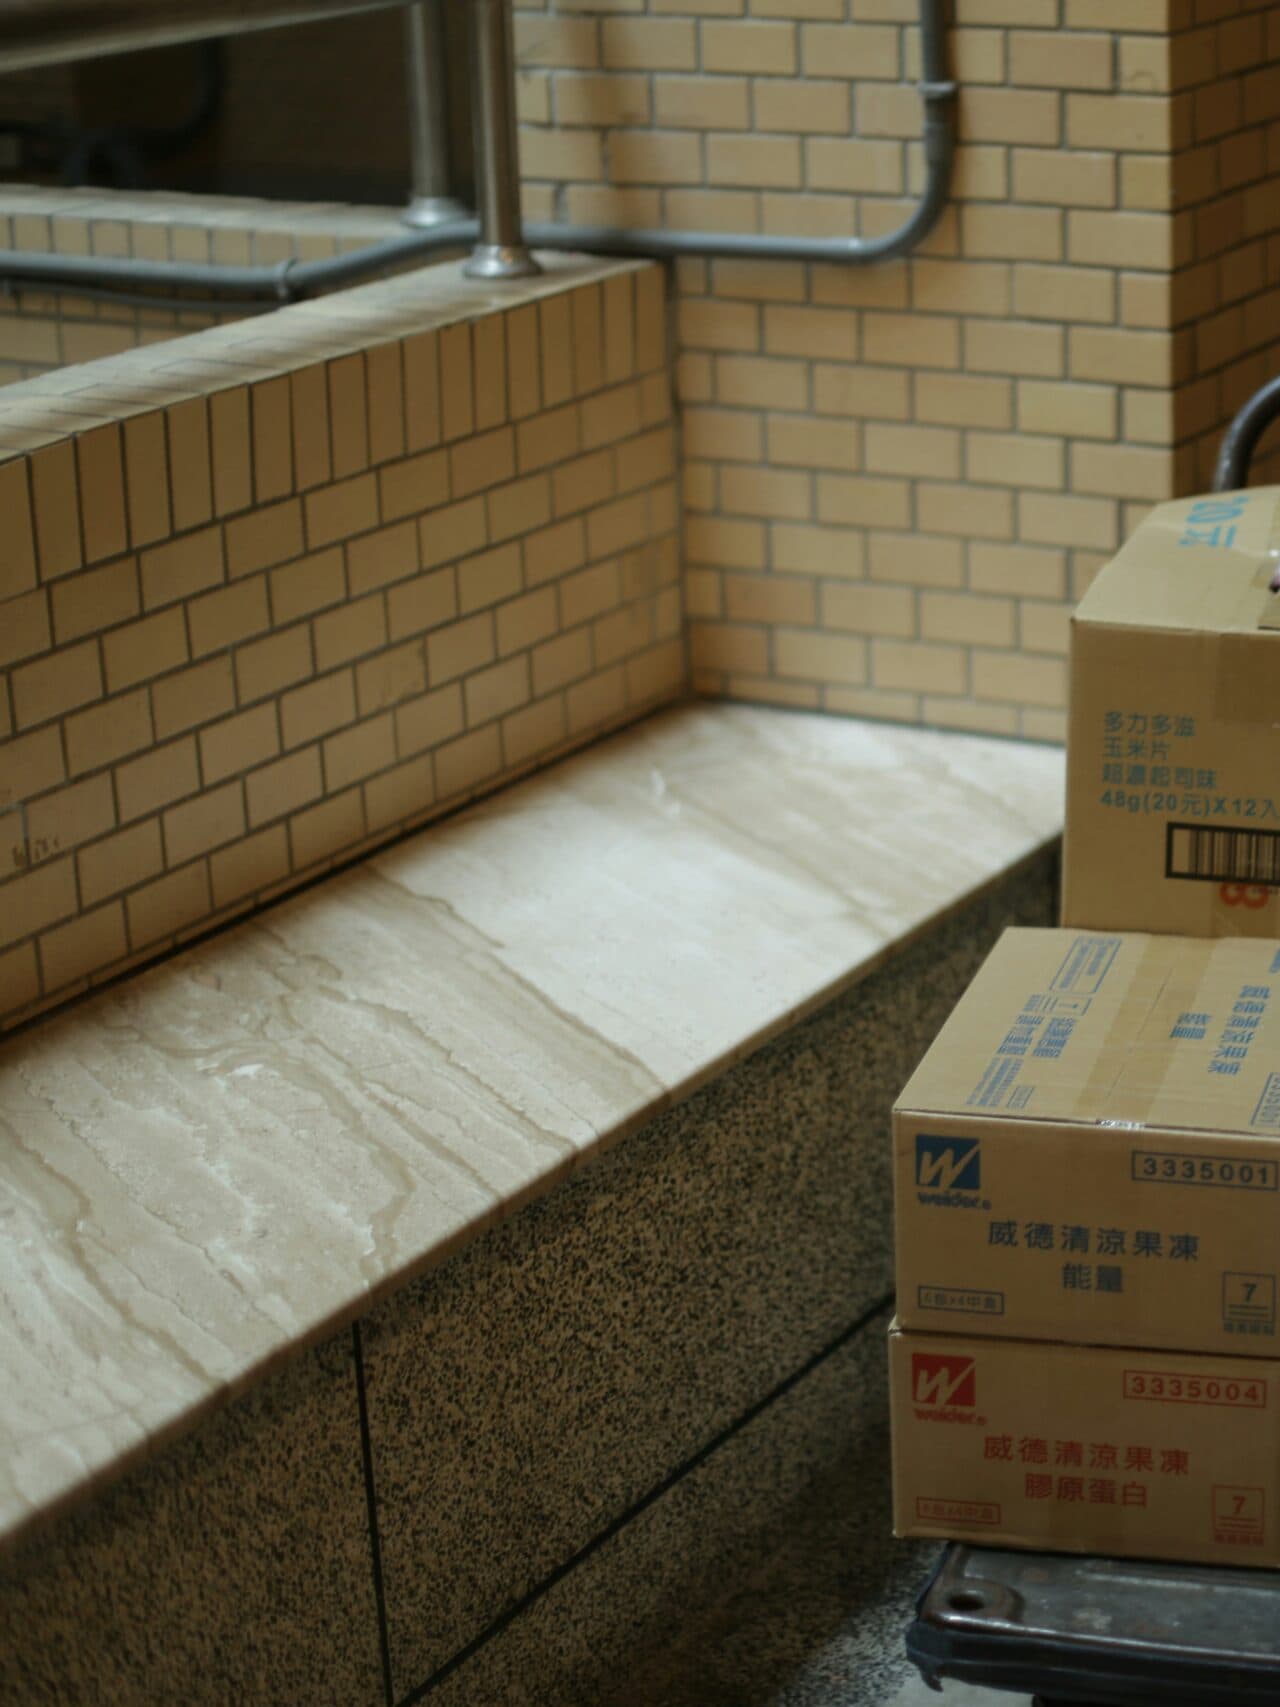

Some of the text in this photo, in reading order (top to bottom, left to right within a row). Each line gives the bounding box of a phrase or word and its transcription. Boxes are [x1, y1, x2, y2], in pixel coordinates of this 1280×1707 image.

[1103, 711, 1196, 738] 多力多滋
[1102, 737, 1172, 761] 玉米片
[1143, 1157, 1271, 1185] 3335001
[988, 1219, 1201, 1262] 威德清涼果凍
[1061, 1264, 1125, 1294] 能量
[1240, 1283, 1257, 1302] 7
[1132, 1376, 1261, 1403] 3335004
[984, 1436, 1191, 1474] 威德清涼果凍
[1025, 1476, 1148, 1507] 膠原蛋白
[1231, 1495, 1248, 1515] 7
